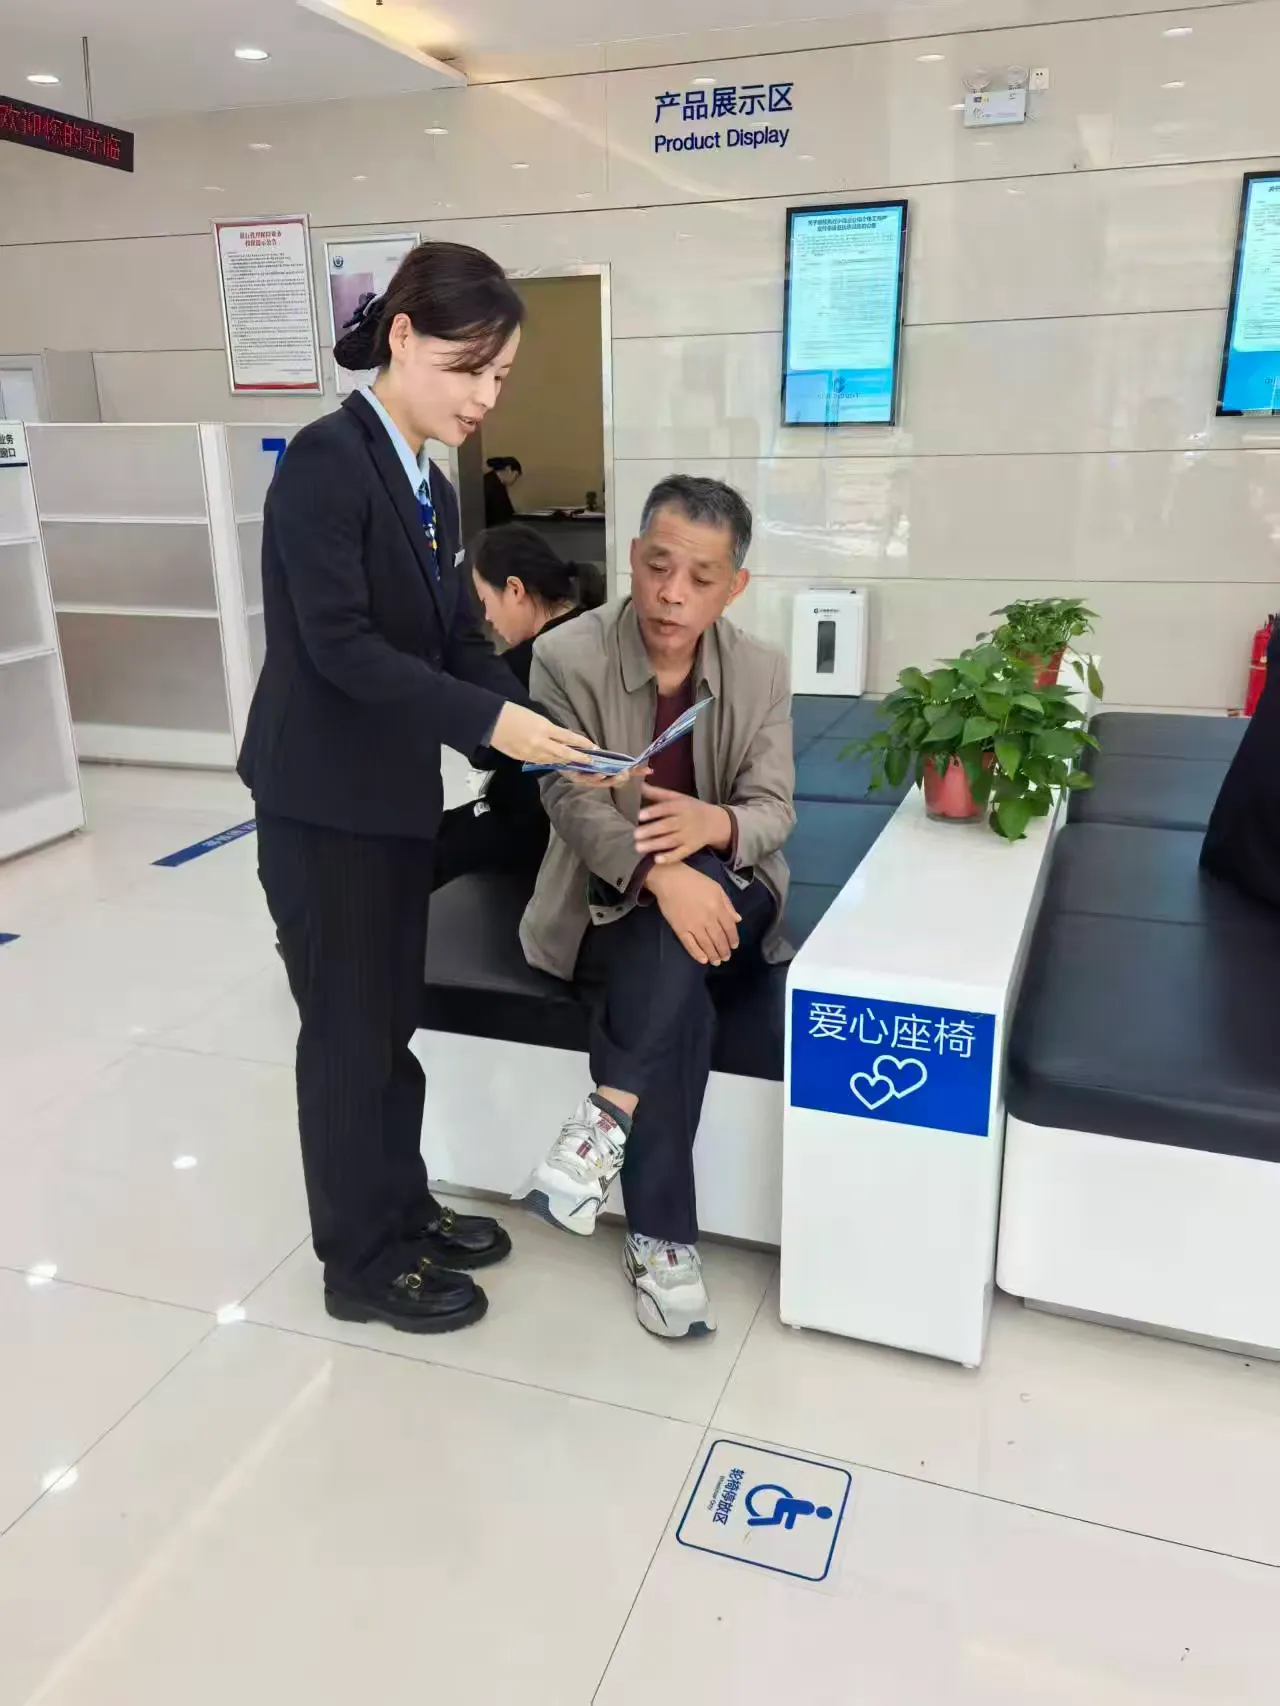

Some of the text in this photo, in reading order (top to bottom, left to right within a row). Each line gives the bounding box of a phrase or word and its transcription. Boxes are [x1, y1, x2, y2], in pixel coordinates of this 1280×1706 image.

[655, 83, 794, 123] 产品展示区
[655, 126, 789, 153] Product Display
[808, 1002, 976, 1058] 爱心座椅
[712, 1468, 745, 1525] 轮椅停放区
